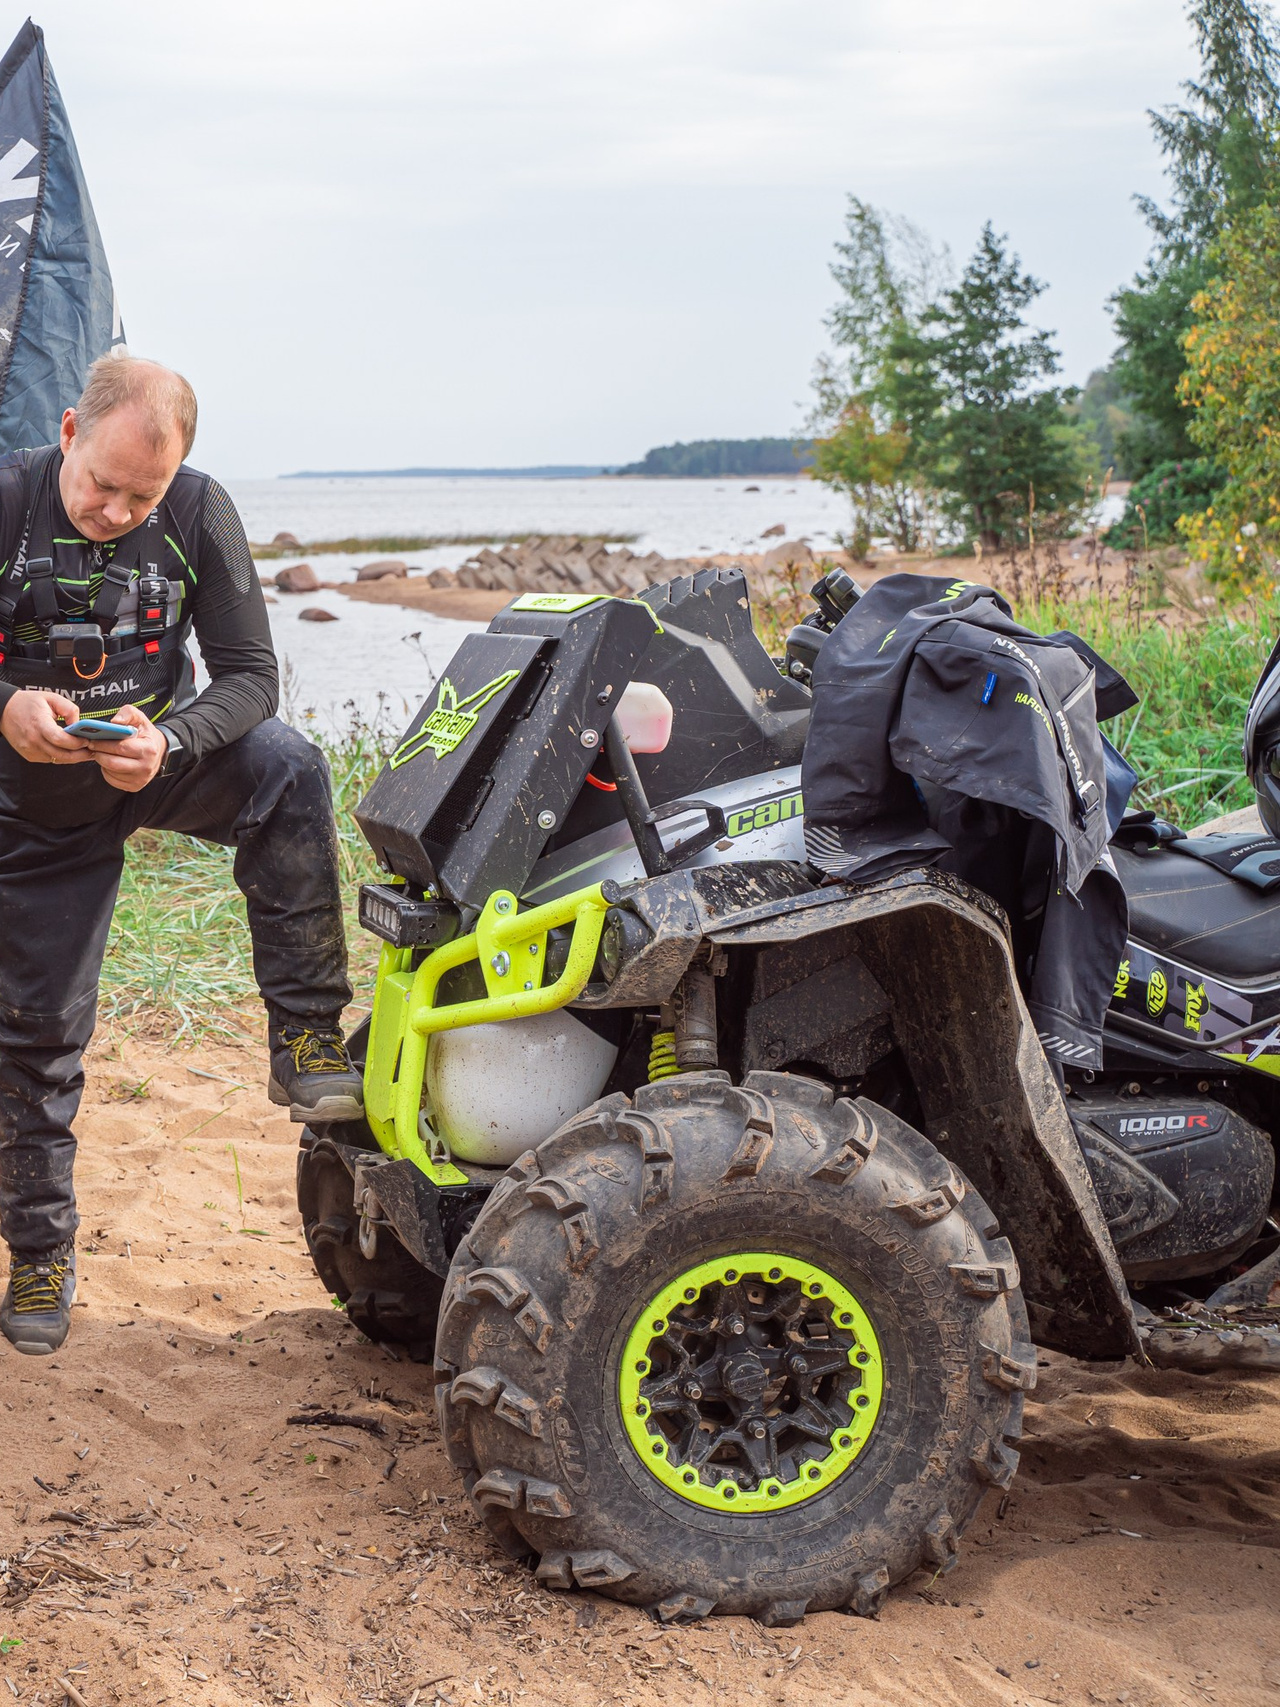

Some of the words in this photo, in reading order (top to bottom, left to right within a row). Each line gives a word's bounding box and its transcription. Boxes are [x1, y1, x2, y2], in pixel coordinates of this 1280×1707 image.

[424, 709, 477, 736] can-am
[430, 735, 458, 747] TEAM
[1149, 969, 1167, 1016] ITP
[1184, 980, 1208, 1034] FOX
[1119, 1115, 1210, 1133] 1000R
[860, 1216, 946, 1300] MUD
